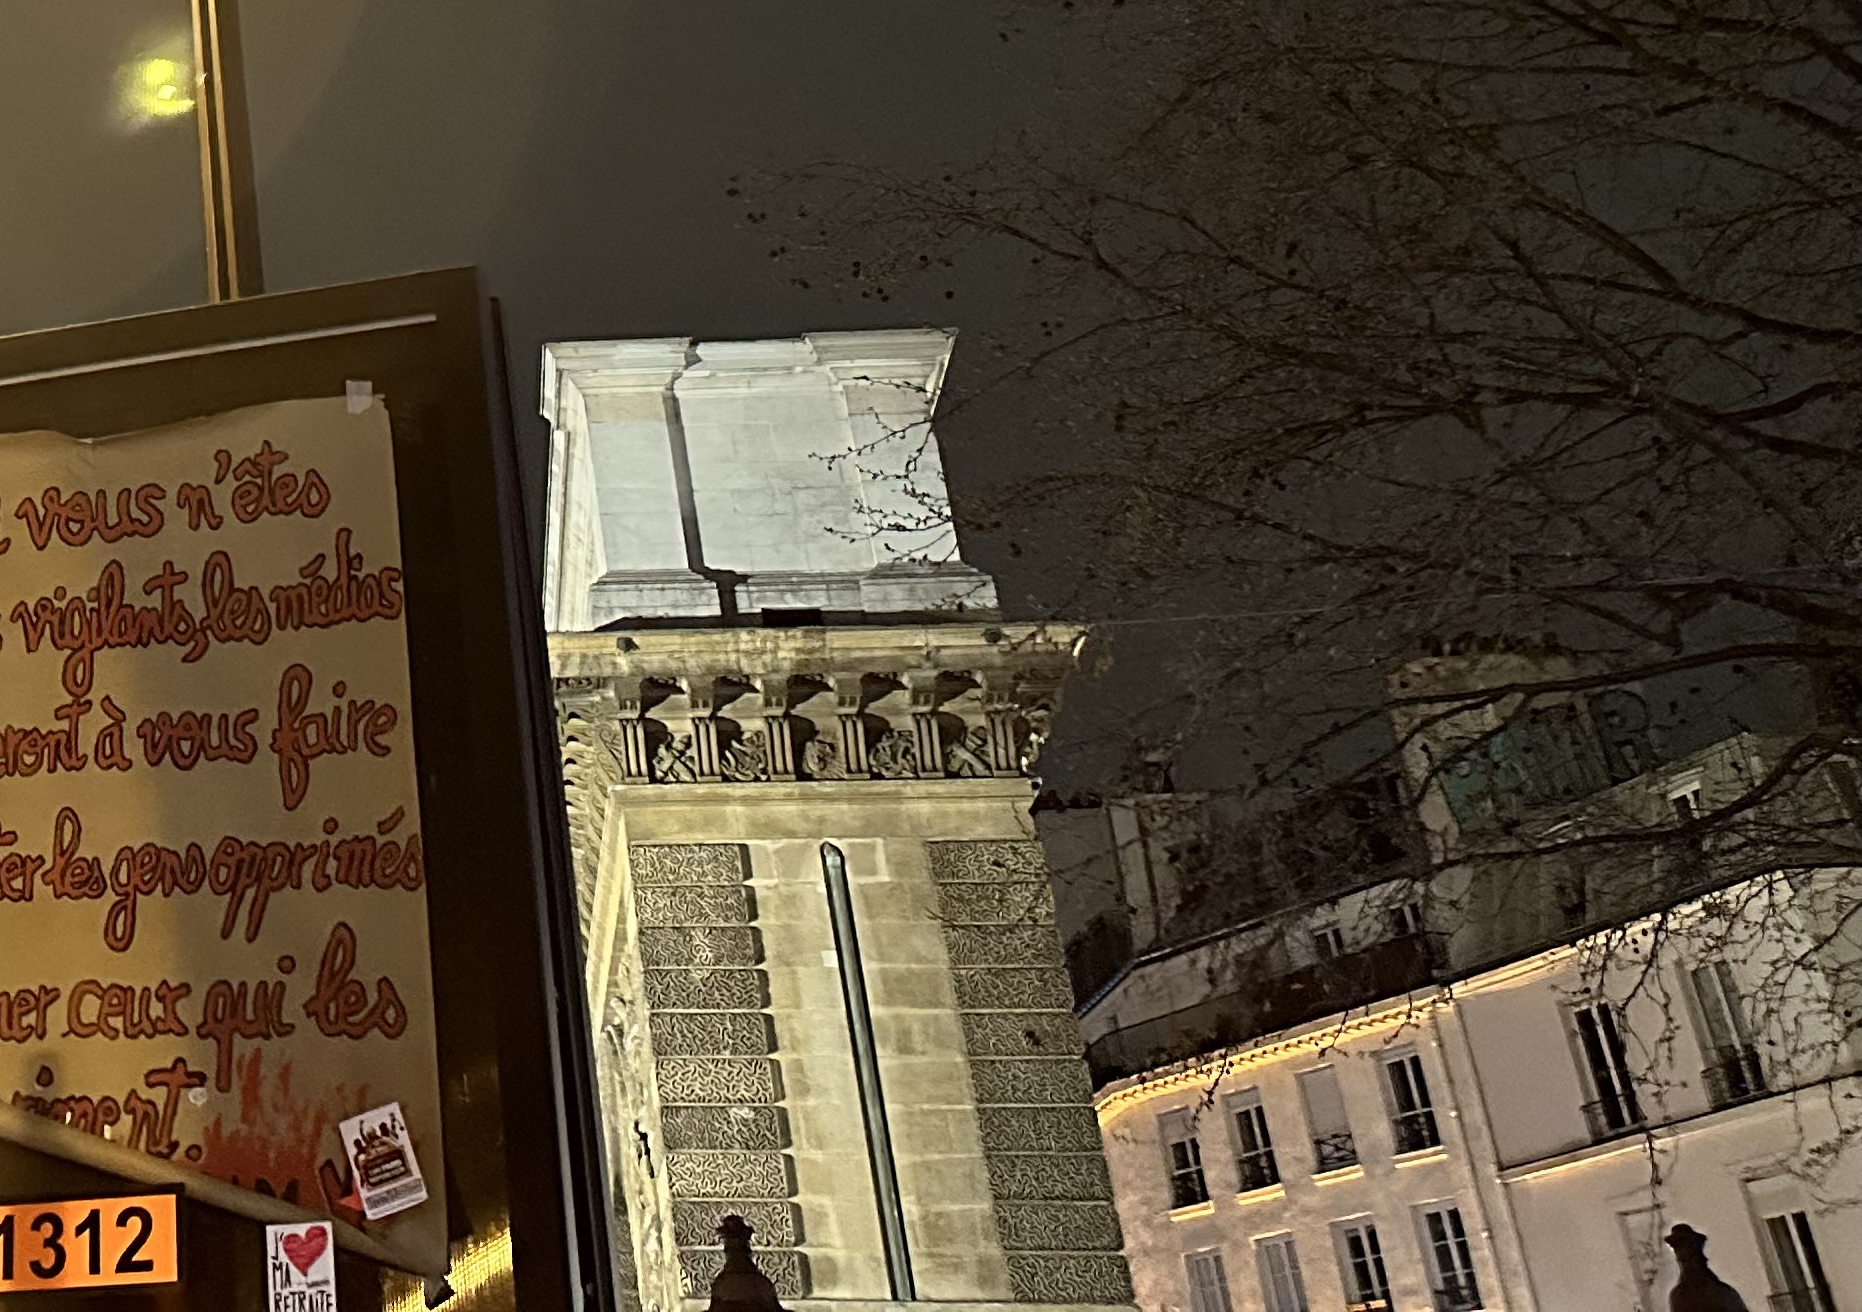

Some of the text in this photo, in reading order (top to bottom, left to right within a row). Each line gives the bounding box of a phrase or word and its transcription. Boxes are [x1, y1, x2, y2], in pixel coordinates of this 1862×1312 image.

[14, 484, 166, 550] vous
[178, 440, 331, 531] n'êtes
[270, 528, 403, 630] médias
[94, 694, 133, 772] à
[136, 708, 259, 771] vous
[270, 663, 398, 811] faire
[40, 806, 108, 901] les
[103, 841, 208, 952] gens
[207, 803, 425, 944] opprimés
[60, 978, 193, 1040] ceux
[196, 954, 296, 1092] qui
[302, 921, 408, 1040] les
[271, 1261, 293, 1290] MA
[273, 1289, 334, 1312] RETRAITE
